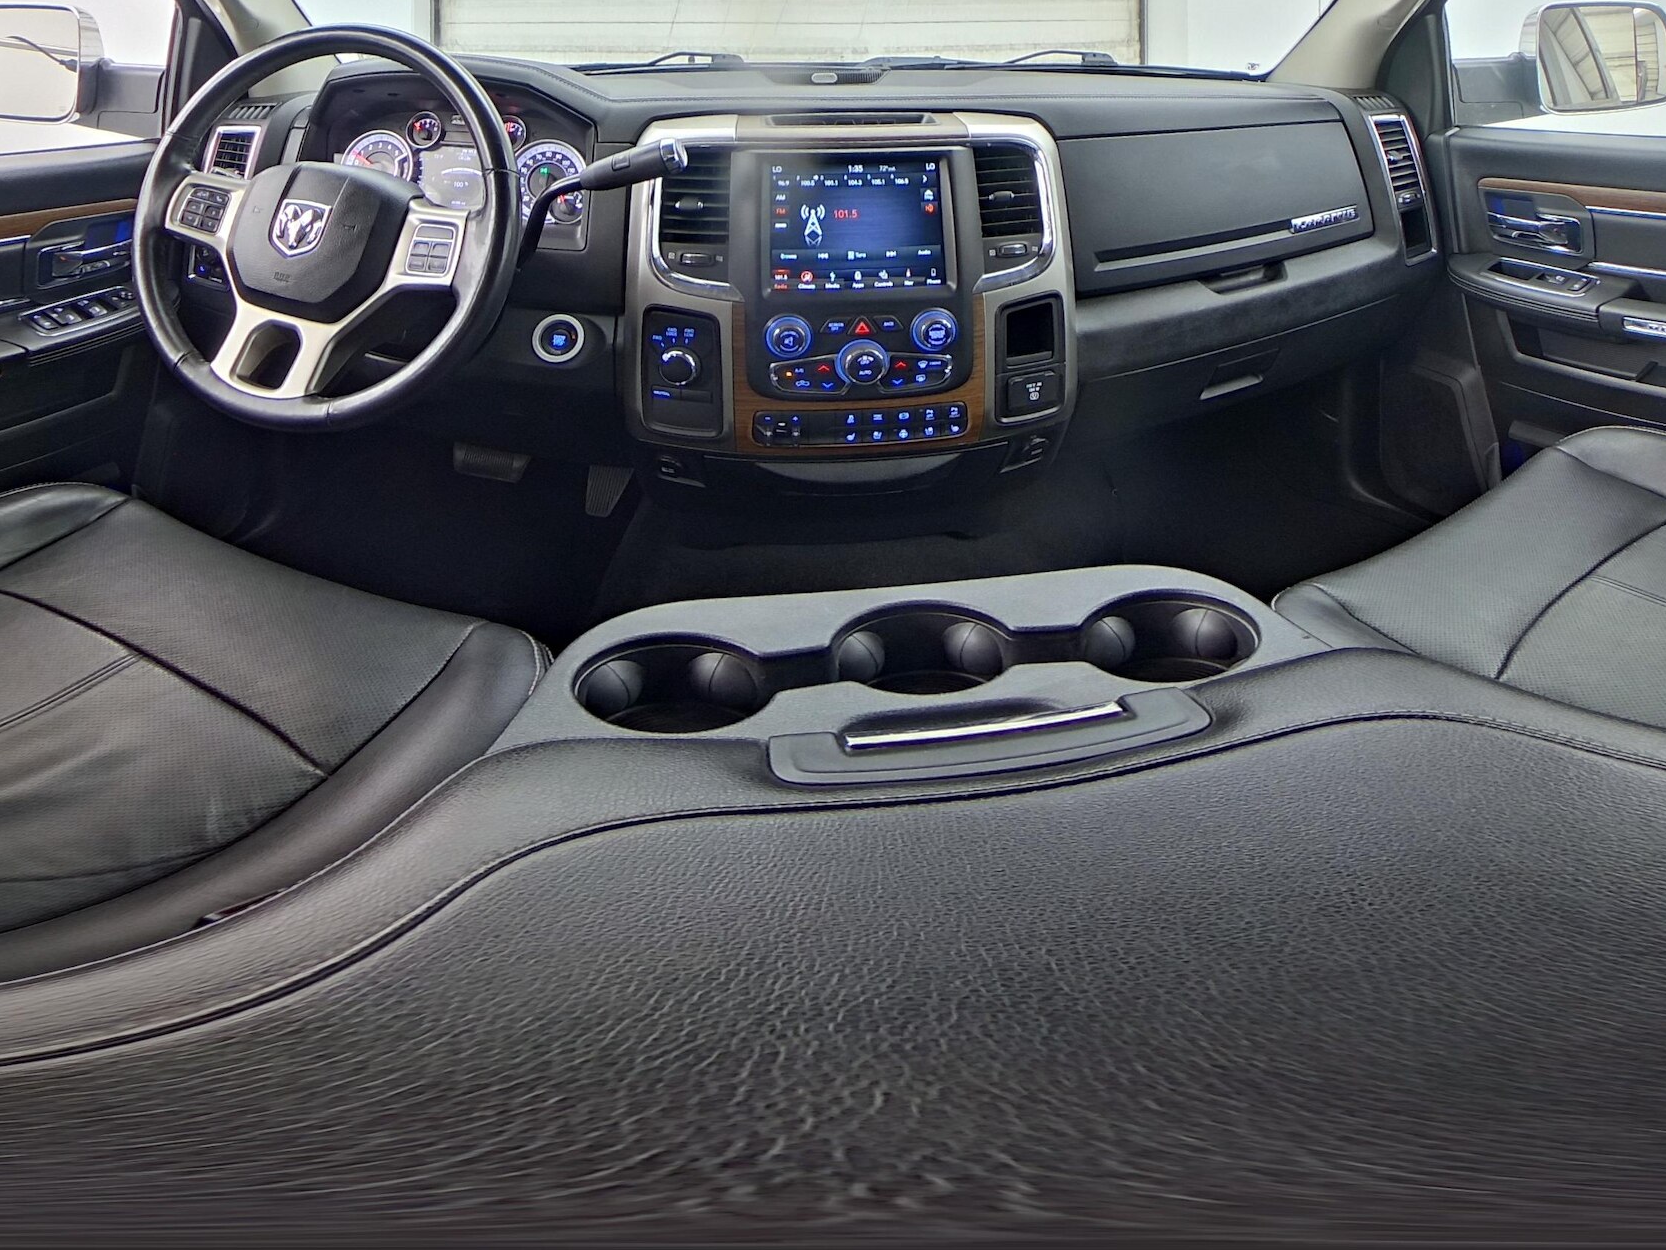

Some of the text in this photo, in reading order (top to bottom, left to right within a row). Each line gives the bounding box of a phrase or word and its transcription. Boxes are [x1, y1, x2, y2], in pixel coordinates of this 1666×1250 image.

[848, 164, 864, 173] 1:35
[925, 162, 936, 171] LO
[833, 209, 858, 219] 101.5
